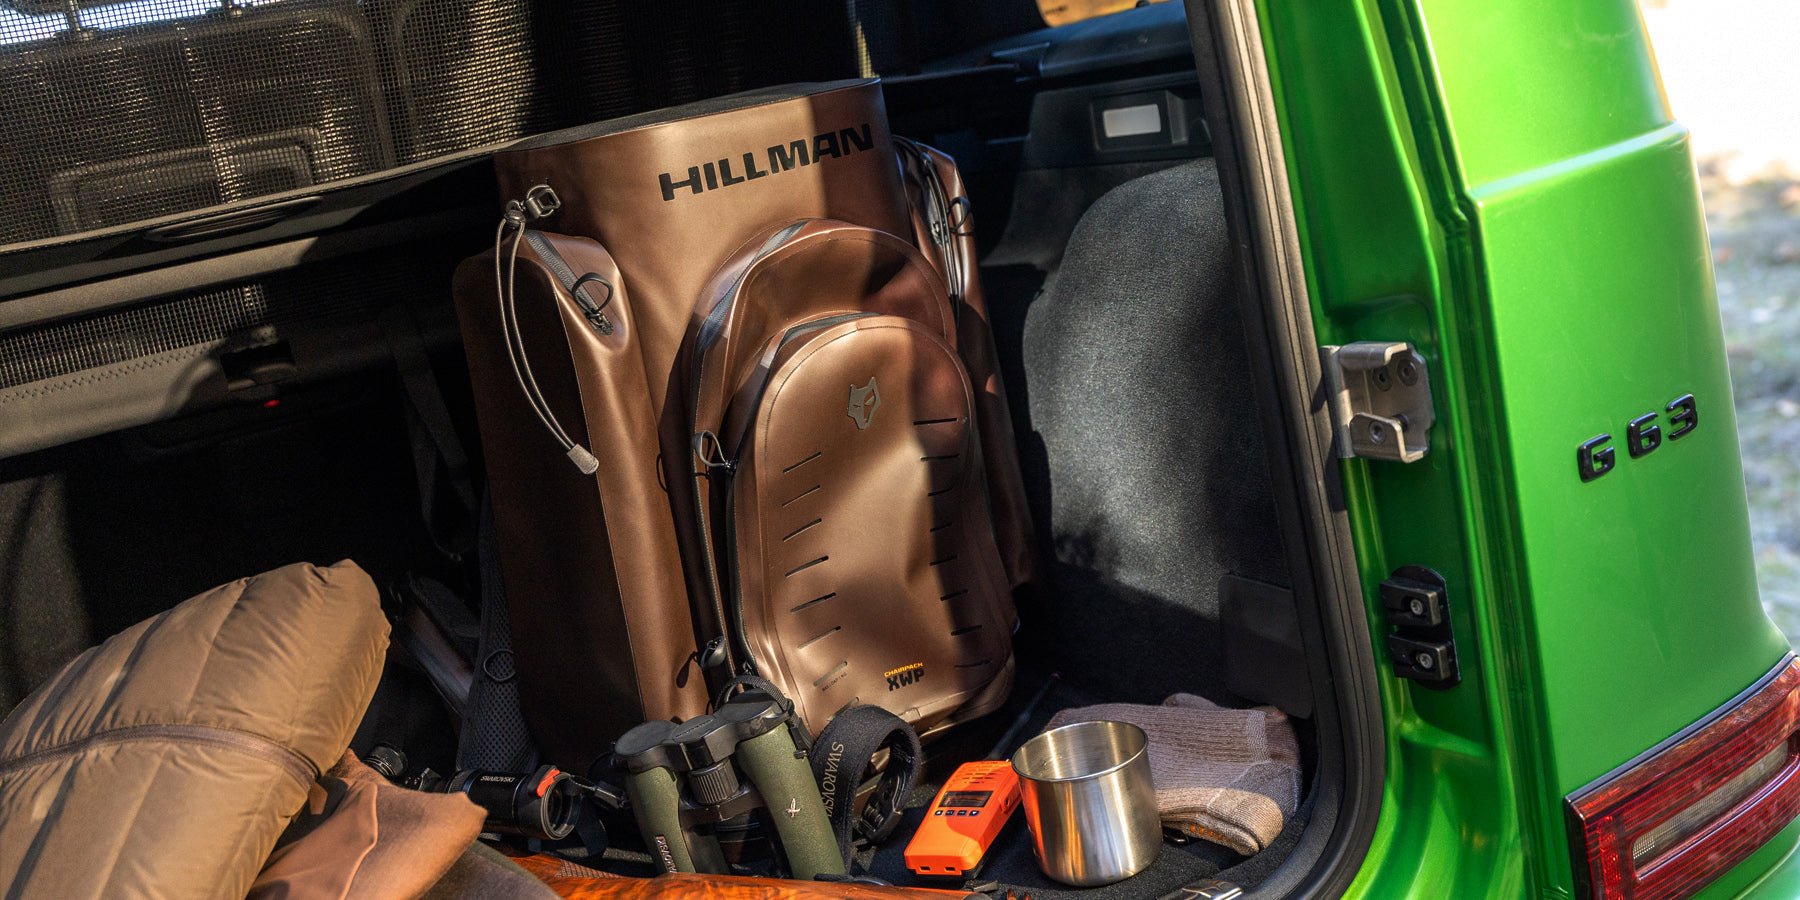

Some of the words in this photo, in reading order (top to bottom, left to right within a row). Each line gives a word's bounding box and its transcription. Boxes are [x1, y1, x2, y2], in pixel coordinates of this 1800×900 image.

[658, 123, 874, 201] HILLMAN
[1577, 433, 1615, 483] G
[1626, 393, 1698, 459] 63
[886, 668, 925, 691] XWP
